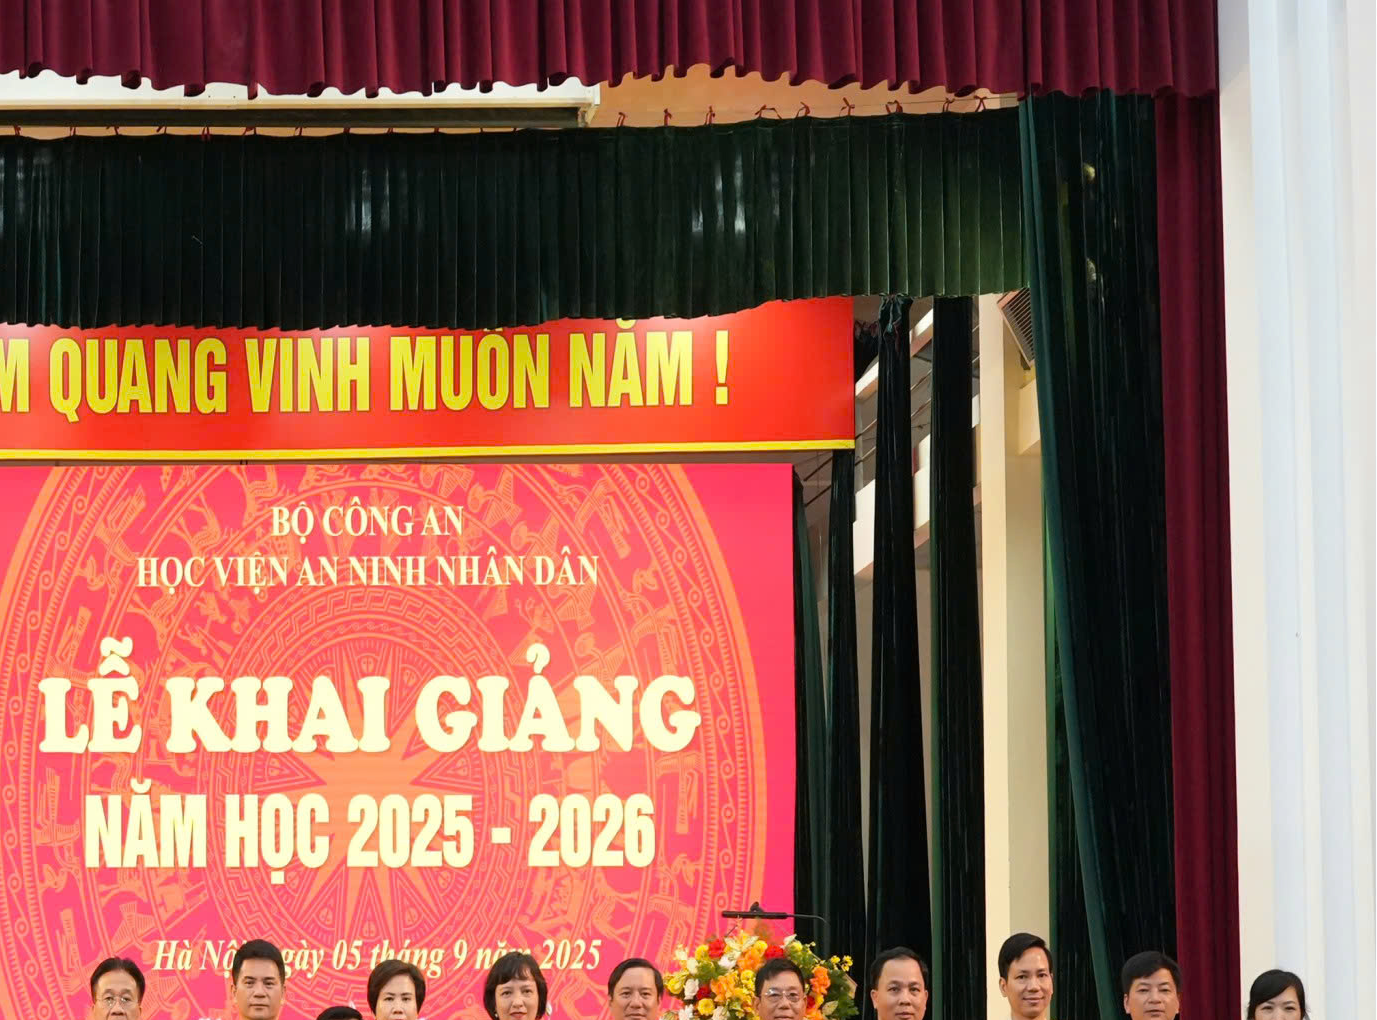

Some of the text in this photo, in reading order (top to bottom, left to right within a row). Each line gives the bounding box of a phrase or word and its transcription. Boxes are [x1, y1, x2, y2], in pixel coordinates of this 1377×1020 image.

[49, 337, 228, 423] QUANG
[244, 336, 371, 413] VINH
[569, 318, 694, 409] NĂM
[270, 496, 465, 545] BỘ CÔNG AN
[136, 546, 600, 595] HỌC VIỆN AN NINH NHÂN DÂN
[38, 636, 702, 755] LỄ KHAI GIẢNG
[84, 778, 207, 869] NĂM
[225, 794, 330, 885] HỌC
[346, 793, 475, 869] 2025
[529, 793, 656, 869] 2026
[153, 939, 193, 971] Hà
[200, 938, 247, 979] Nộ
[280, 938, 325, 979] gày
[332, 939, 363, 971] 05
[453, 939, 468, 971] 9
[540, 938, 603, 971] 2025
